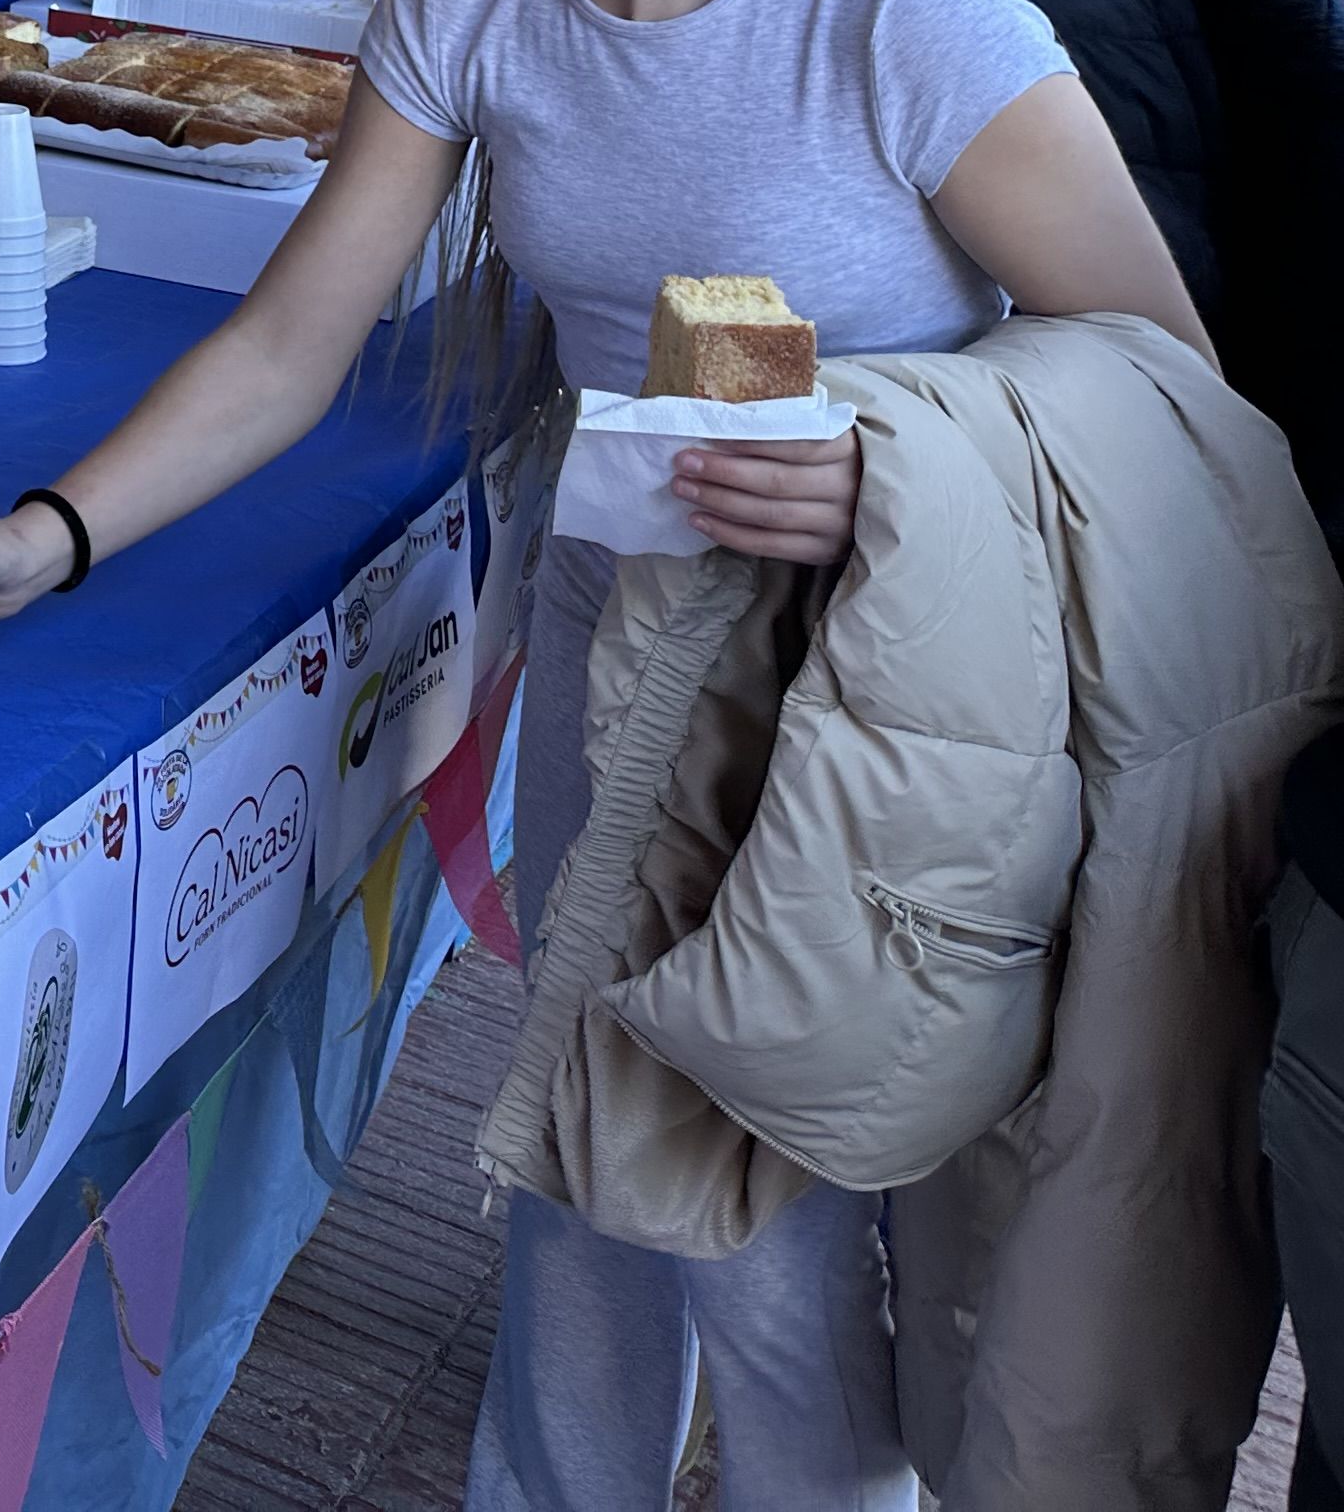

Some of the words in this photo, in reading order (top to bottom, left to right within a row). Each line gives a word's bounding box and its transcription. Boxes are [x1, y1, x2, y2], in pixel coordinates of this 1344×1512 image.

[417, 611, 459, 668] Jan
[383, 667, 445, 728] PASTISSERIA
[177, 861, 219, 942] Cal
[221, 796, 300, 902] Nicasi
[216, 872, 273, 930] TRADICIONAL
